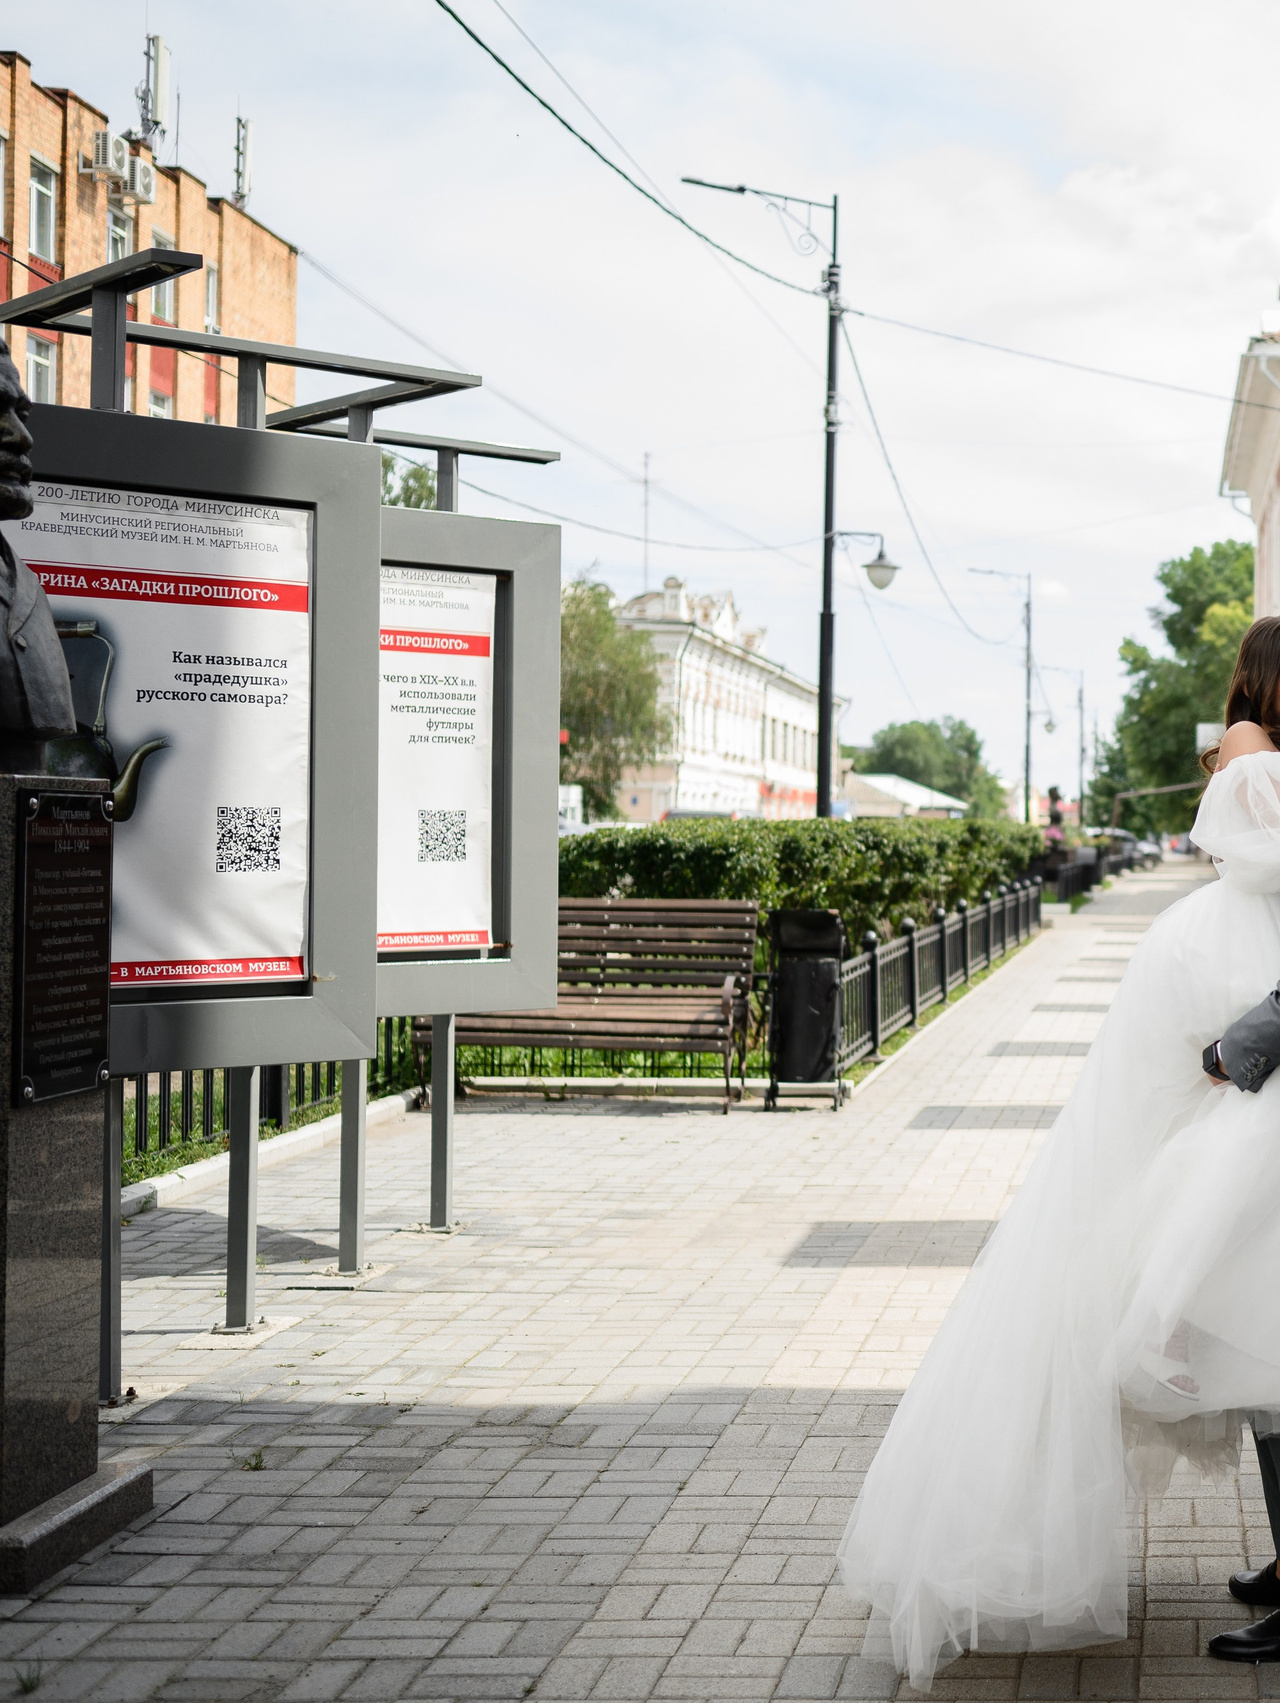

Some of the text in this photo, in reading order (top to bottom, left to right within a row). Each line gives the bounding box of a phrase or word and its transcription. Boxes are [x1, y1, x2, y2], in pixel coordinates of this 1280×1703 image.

[37, 485, 280, 520] 200-ЛЕТИЮ ГОРОДА МИНУСИНСКА
[60, 512, 244, 537] МИНУСИНСКИЙ РЕГИОНАЛЬНЫЙ
[21, 521, 279, 552] КРАЕВЕДЧЕСКИЙ МУЗЕЙ ИМ. Н. М. МАРТЬЯНОВА
[400, 570, 471, 585] МИНУСИНСКА
[36, 572, 279, 602] РИНА «ЗАГАДКИ ПРОШЛОГО»
[419, 600, 469, 611] МАРТЬЯНОВА
[396, 635, 469, 650] ПРОШЛОГО»
[172, 650, 288, 669] Как назывался
[174, 672, 288, 688] «прадедушка»
[383, 674, 409, 684] чего
[410, 676, 418, 684] в
[136, 689, 288, 708] русского самовара?
[399, 690, 477, 702] использовали
[390, 704, 477, 716] металлические
[426, 718, 474, 732] футляры
[408, 734, 476, 745] для спичек?
[52, 806, 91, 823] Мартьянов
[32, 822, 108, 836] Николай Михайлович
[55, 839, 90, 853] 1844-1904
[377, 933, 479, 946] РТЬЯНОВСКОМ МУЗЕЕ!
[120, 967, 129, 977] В
[134, 963, 243, 977] МАРТЬЯНОВСКОМ
[248, 961, 290, 973] МУЗЕЕ!
